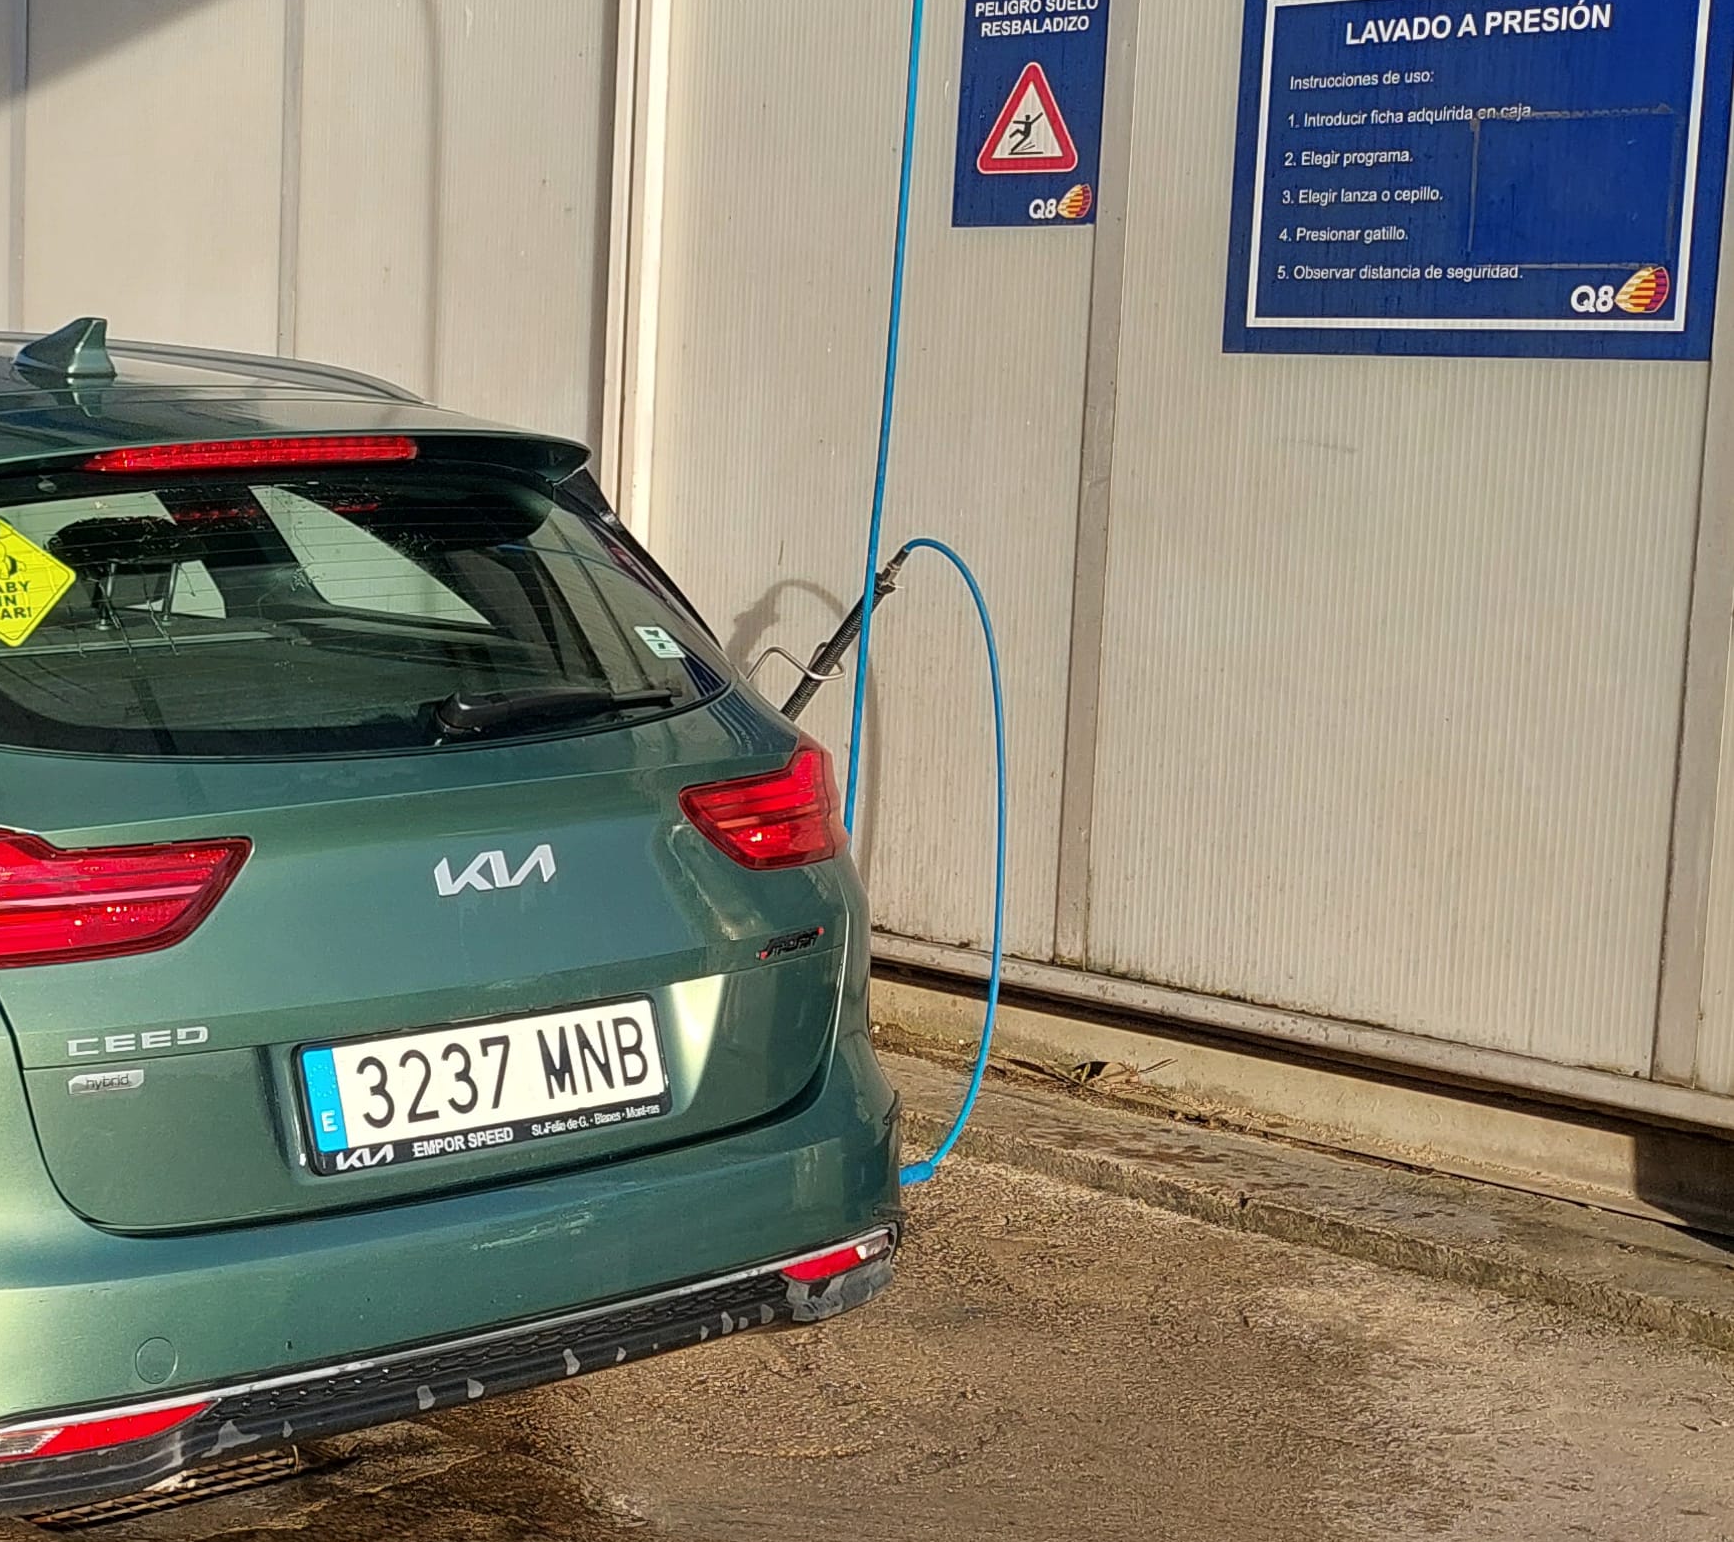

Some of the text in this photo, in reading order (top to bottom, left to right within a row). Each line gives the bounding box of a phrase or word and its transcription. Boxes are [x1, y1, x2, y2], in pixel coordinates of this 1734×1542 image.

[981, 16, 1089, 37] RESBALADIZO
[1345, 0, 1612, 45] LAVADO A PRESIÓN
[1290, 70, 1434, 90] Instrucciones de uso:
[1288, 114, 1300, 128] 1.
[1304, 112, 1367, 127] Introducir
[1371, 109, 1404, 125] ficha
[1408, 106, 1473, 125] adquirida
[1477, 108, 1495, 120] en
[1284, 150, 1413, 168] 2. Elegir programa.
[1282, 186, 1443, 206] 3. Elegir lanza o cepillo.
[1029, 198, 1057, 219] Q8
[1279, 226, 1409, 244] 4. Presionar gatillo.
[1277, 264, 1523, 283] 5. Observar distancia de seguridad.
[1570, 285, 1615, 313] Q8
[434, 844, 556, 896] KIA
[67, 1026, 208, 1056] CEED
[86, 1074, 130, 1091] hybrid
[356, 1016, 648, 1129] 3237 MNB
[321, 1110, 338, 1132] E
[412, 1135, 466, 1157] EMPOR
[468, 1126, 515, 1148] SPEED
